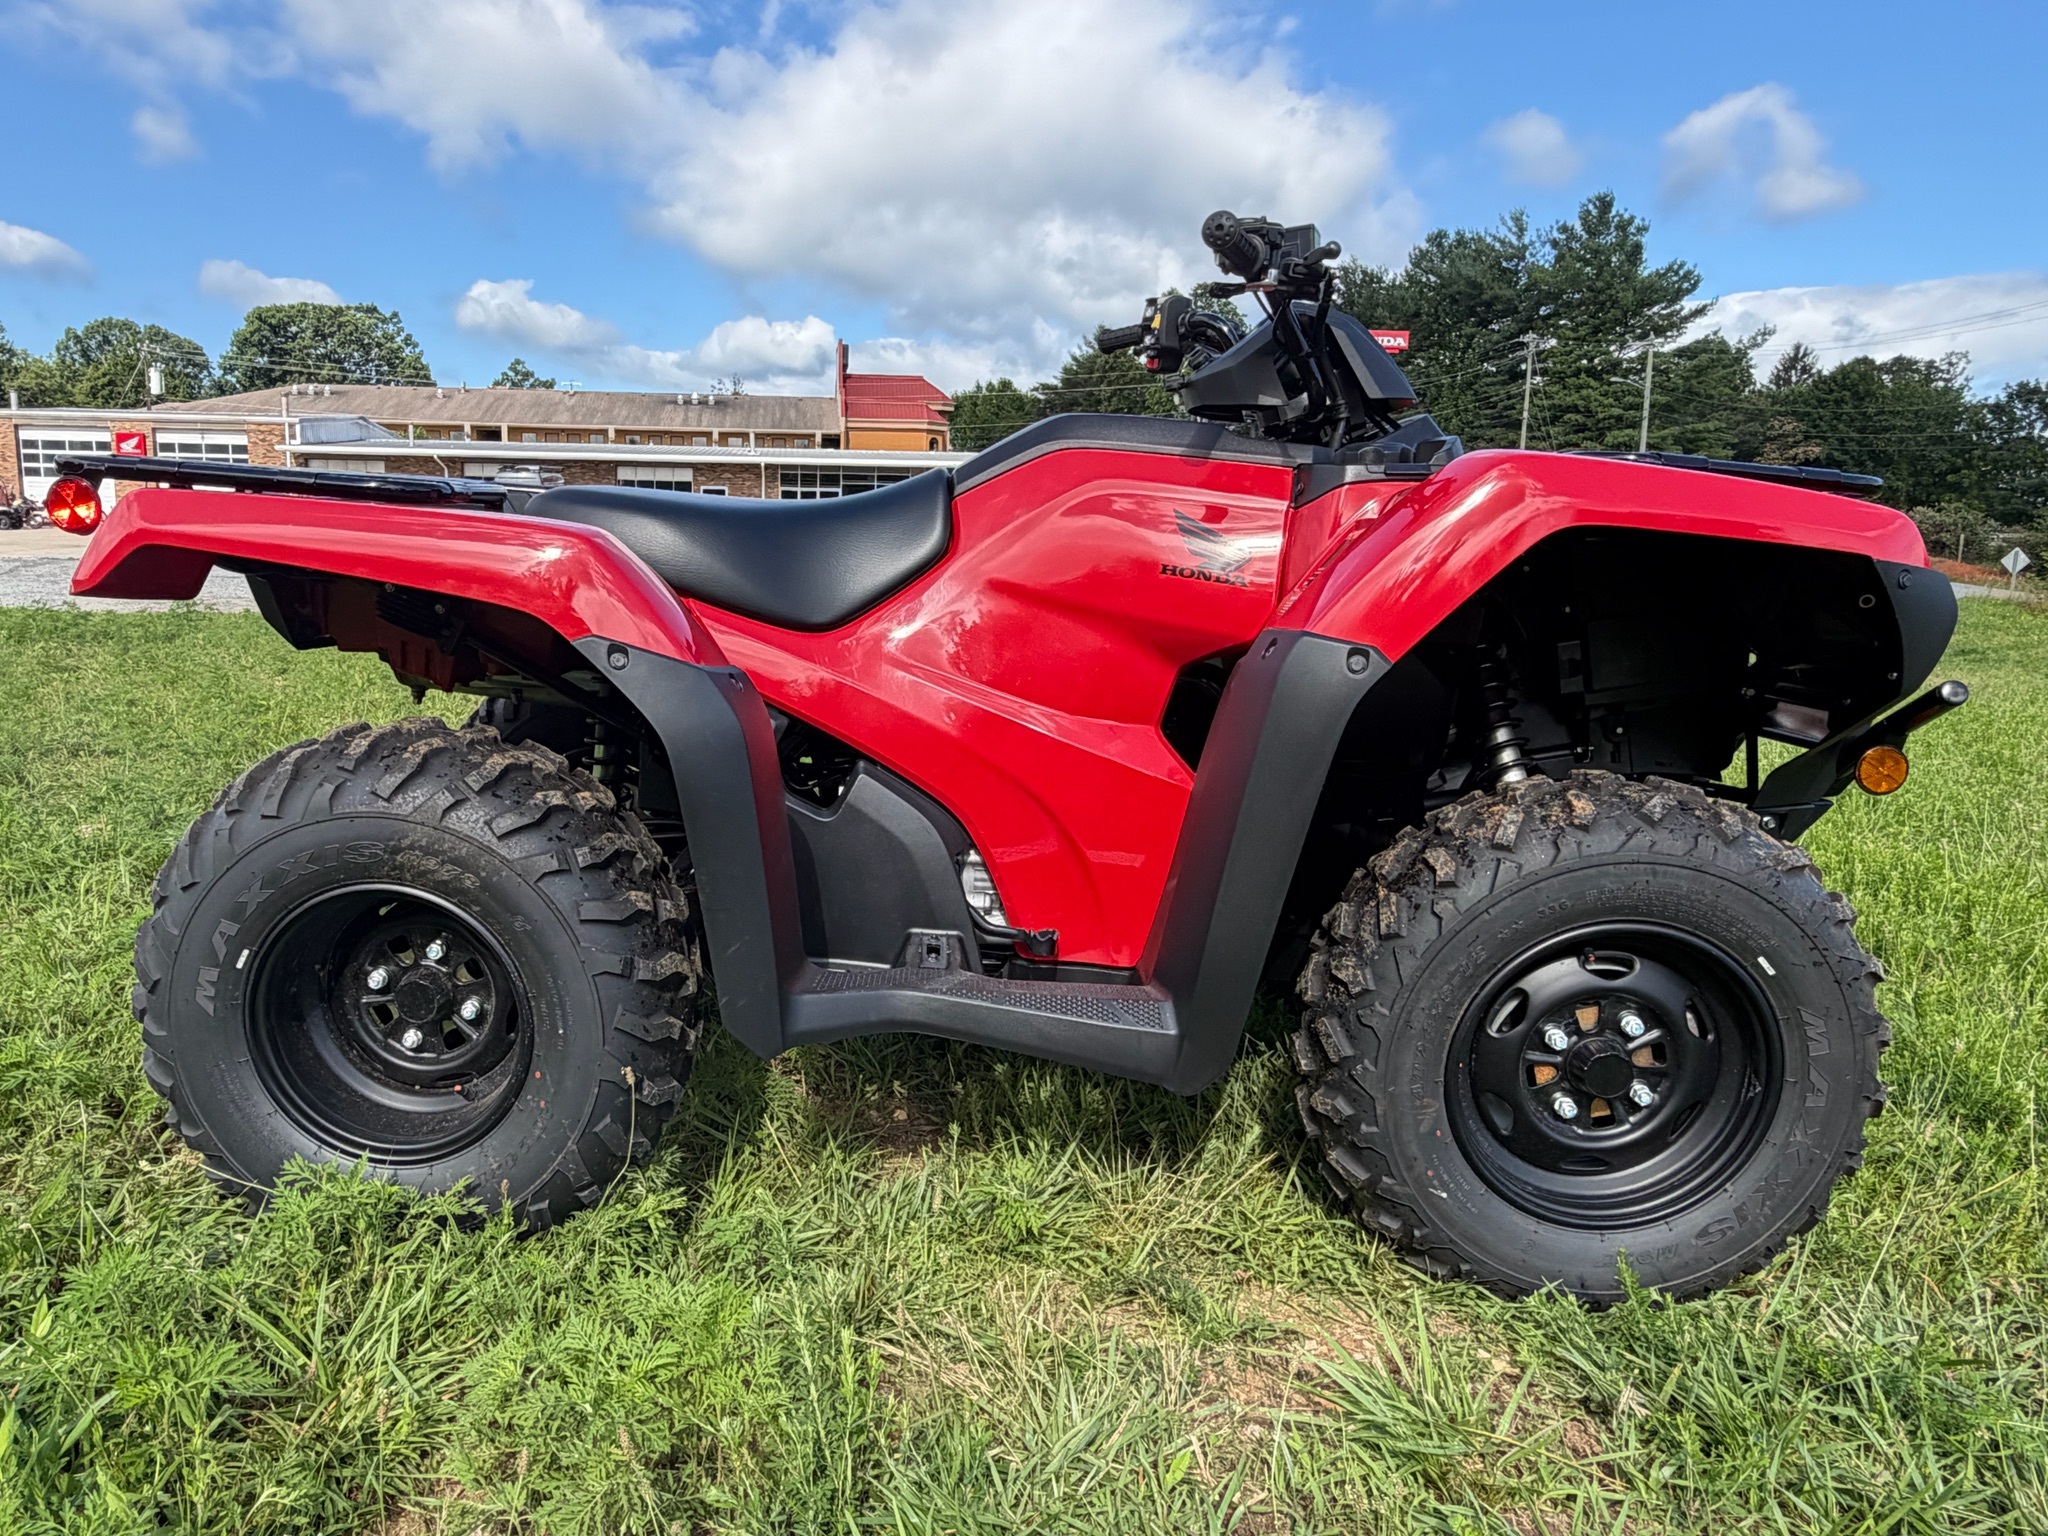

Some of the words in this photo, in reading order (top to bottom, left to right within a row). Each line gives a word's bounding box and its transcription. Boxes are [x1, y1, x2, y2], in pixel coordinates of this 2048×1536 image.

[1159, 563, 1249, 588] HONDA
[195, 841, 386, 1018] MAXXIS
[1694, 1006, 1831, 1247] MAXXIS
